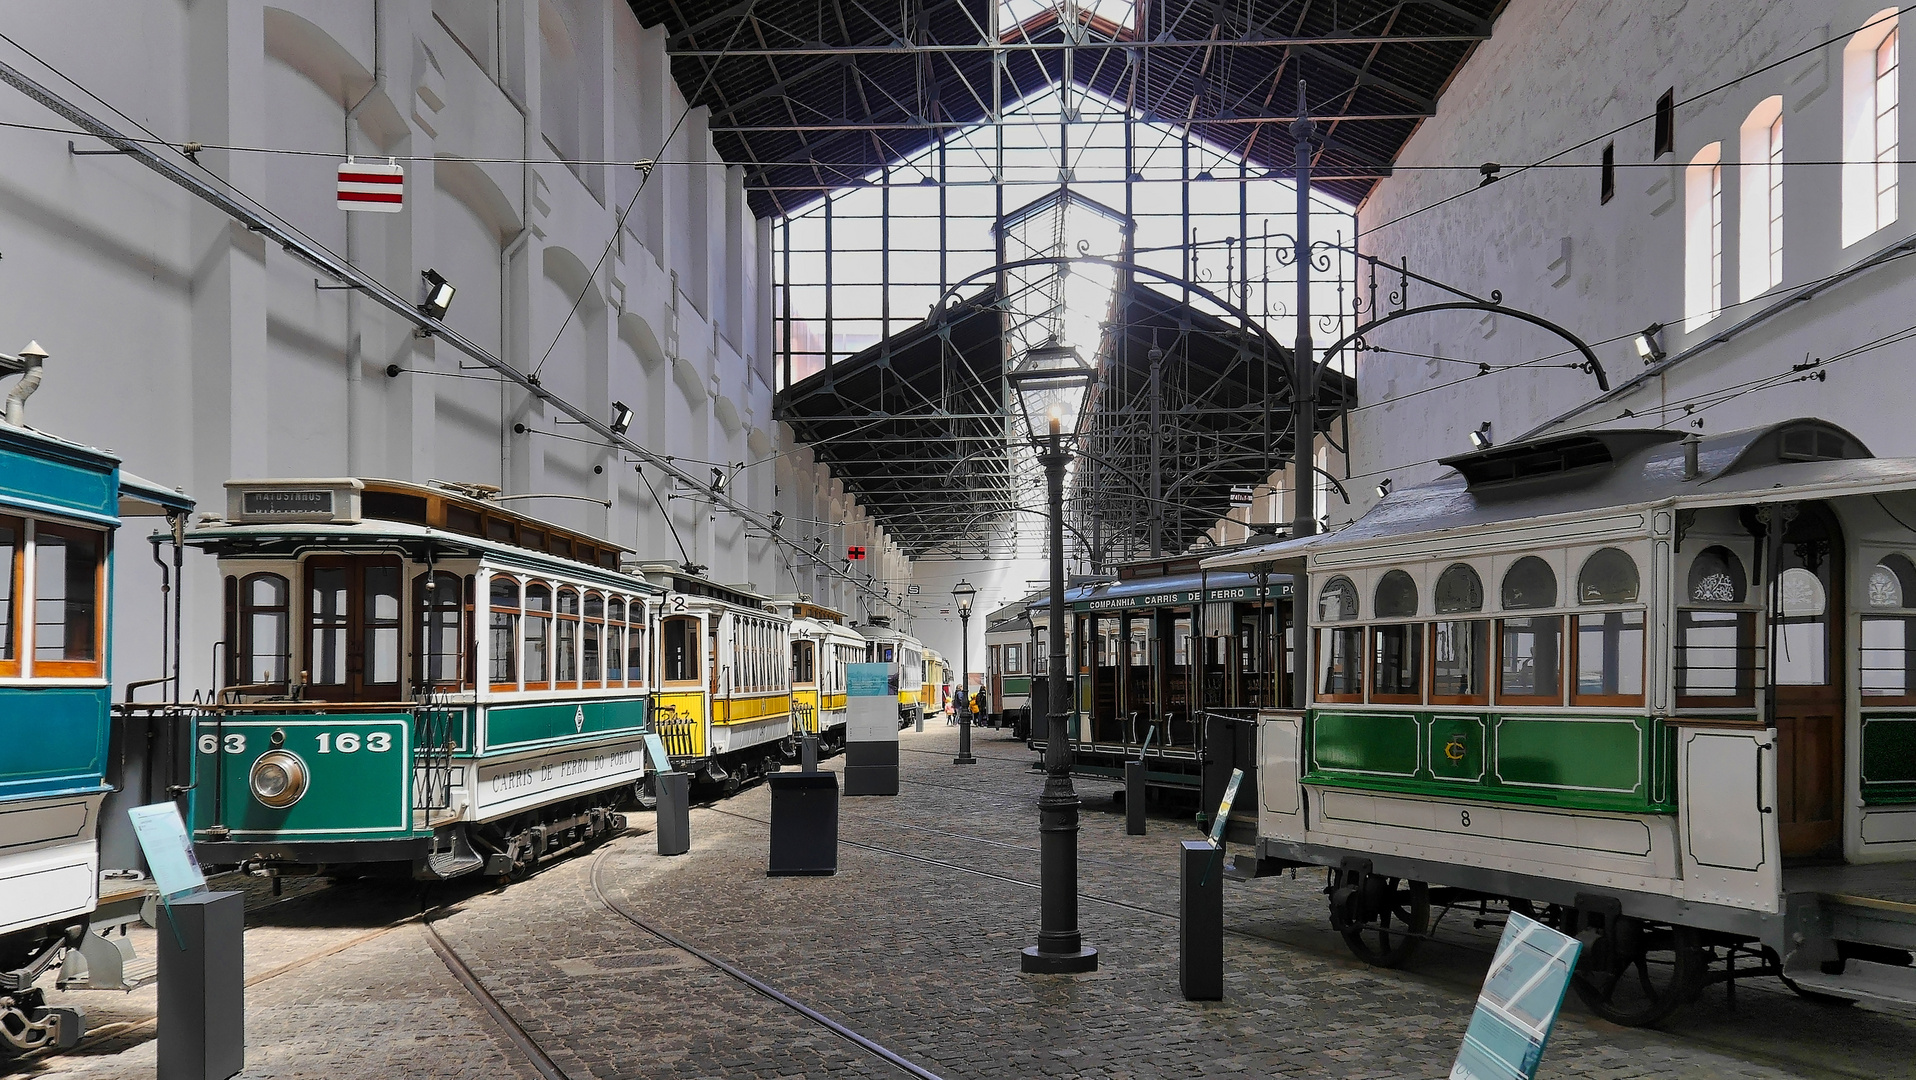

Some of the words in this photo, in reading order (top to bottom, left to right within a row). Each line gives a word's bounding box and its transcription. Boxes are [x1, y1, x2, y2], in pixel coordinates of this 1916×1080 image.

[674, 596, 685, 611] 2
[1089, 598, 1136, 609] COMPANHIA
[1144, 594, 1178, 604] CARRIS
[1188, 592, 1201, 601] DE
[1211, 589, 1244, 599] FERRO
[799, 628, 810, 639] 14
[314, 732, 392, 754] 163
[492, 772, 532, 792] CARRIS
[541, 765, 553, 782] DE
[560, 757, 588, 777] FERRO
[594, 755, 604, 771] DO
[610, 750, 633, 767] PORTO
[1461, 810, 1471, 827] 8
